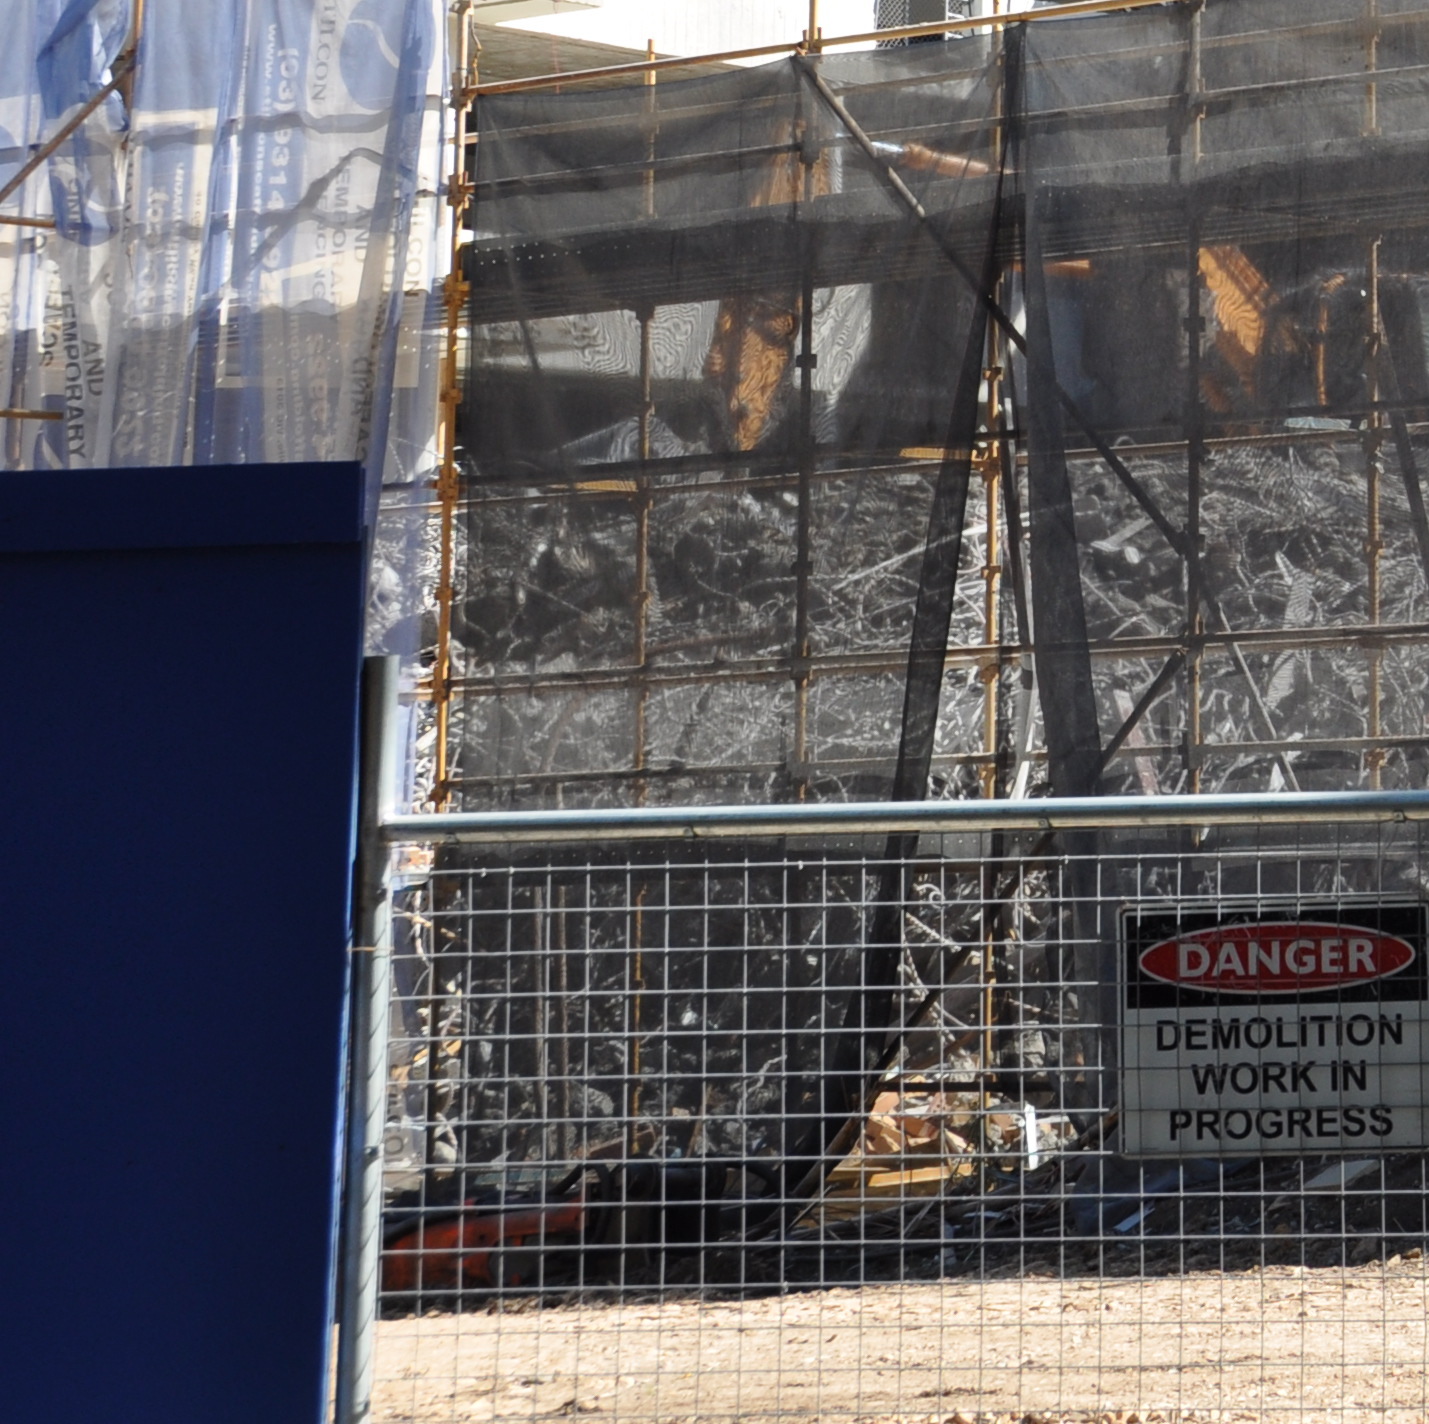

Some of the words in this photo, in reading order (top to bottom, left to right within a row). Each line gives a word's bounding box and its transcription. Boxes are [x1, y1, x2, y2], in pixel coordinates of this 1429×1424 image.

[272, 47, 299, 112] (03)
[267, 128, 293, 211] 9314
[65, 285, 87, 459] TEMPORARY
[82, 339, 105, 397] AND
[1178, 937, 1377, 979] DANGER
[1156, 1013, 1403, 1052] DEMOLITION
[1192, 1060, 1317, 1096] WORK
[1330, 1059, 1367, 1092] IN
[1169, 1105, 1394, 1141] PROGRESS
